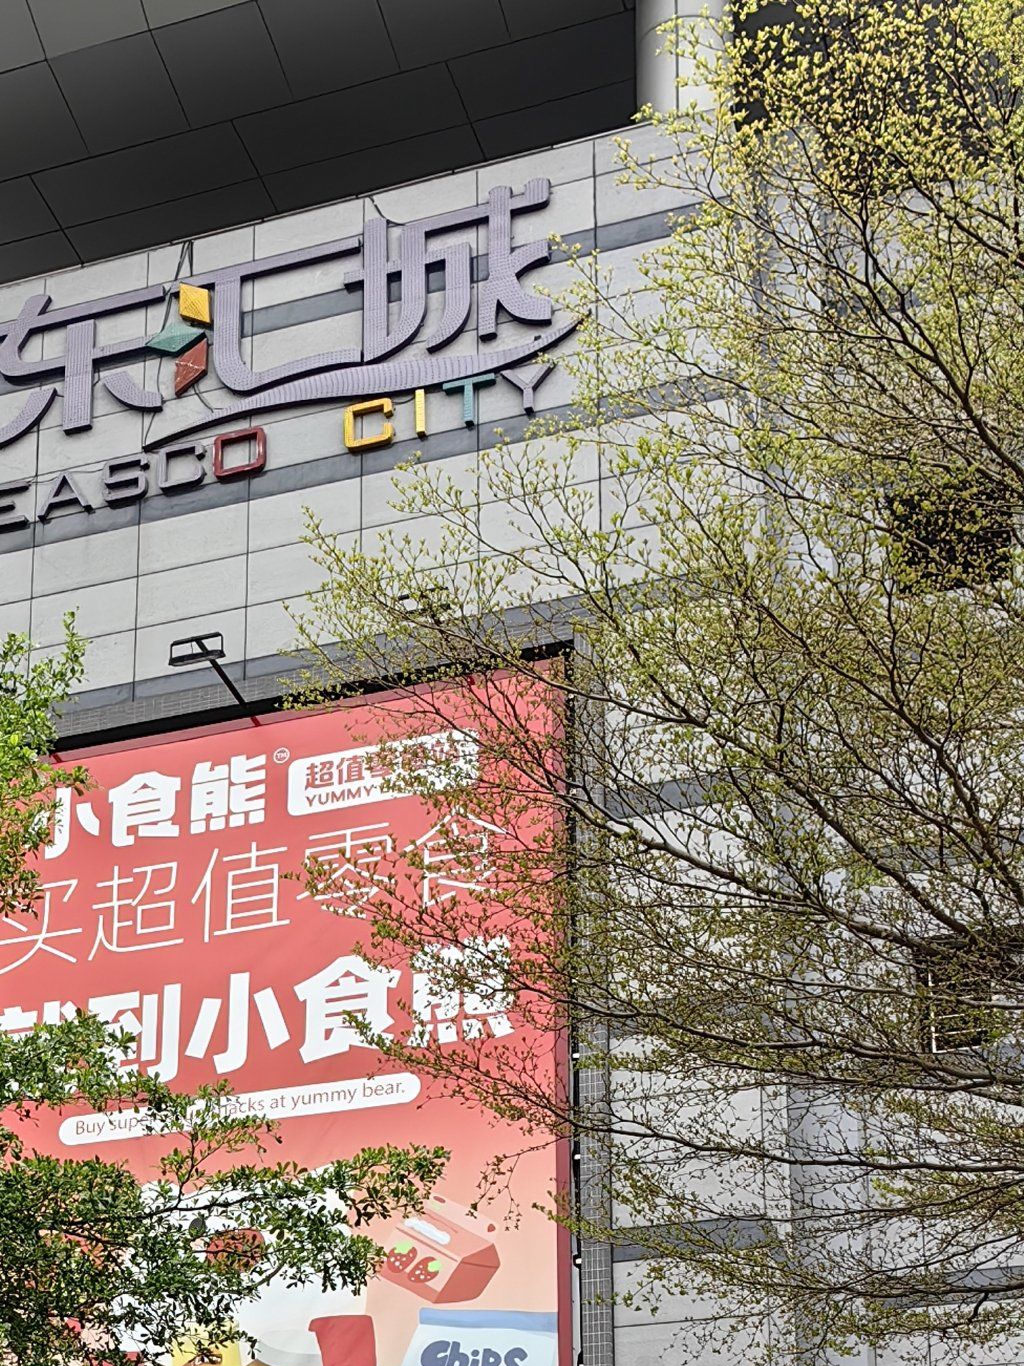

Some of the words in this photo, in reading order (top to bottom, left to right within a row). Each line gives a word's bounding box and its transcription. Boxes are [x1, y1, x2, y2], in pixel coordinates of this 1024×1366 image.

[343, 361, 555, 453] CITY
[28, 753, 267, 860] 小食熊
[75, 1119, 105, 1136] Buy
[269, 1096, 287, 1110] at
[289, 1086, 356, 1110] yummy
